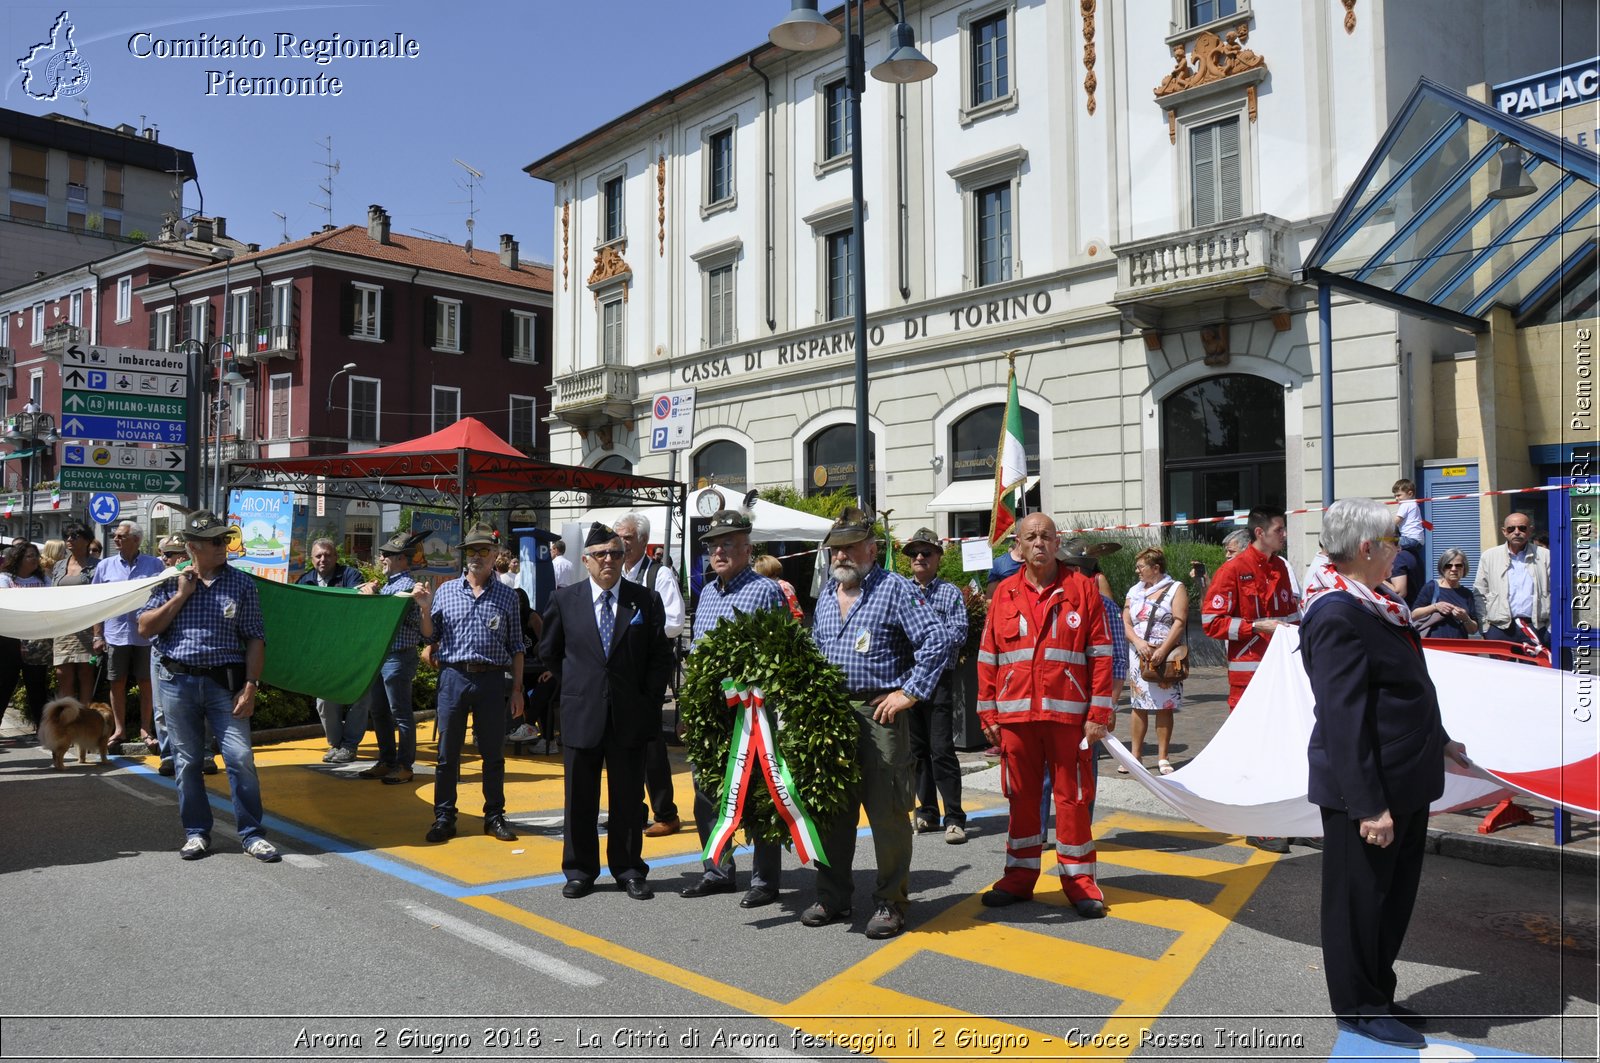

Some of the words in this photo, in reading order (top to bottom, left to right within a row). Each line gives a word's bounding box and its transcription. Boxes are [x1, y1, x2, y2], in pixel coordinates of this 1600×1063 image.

[681, 357, 732, 384] CASSA
[744, 350, 763, 373] DI
[777, 324, 884, 366] RISPARMO
[904, 317, 928, 341] DI
[950, 290, 1052, 331] TORINO
[119, 353, 183, 369] imbarcadero
[90, 401, 103, 411] A8
[107, 401, 182, 415] MILANO-VARESE
[116, 420, 160, 431] MILANO
[168, 423, 182, 432] 64
[116, 430, 162, 441] NOVARA
[169, 433, 182, 442] 37
[655, 429, 665, 447] P
[63, 480, 126, 490] GRAVELLONA
[129, 482, 138, 490] T.
[146, 478, 160, 487] A26
[241, 497, 280, 512] ARONA
[422, 518, 452, 532] ARONA
[539, 545, 549, 559] P
